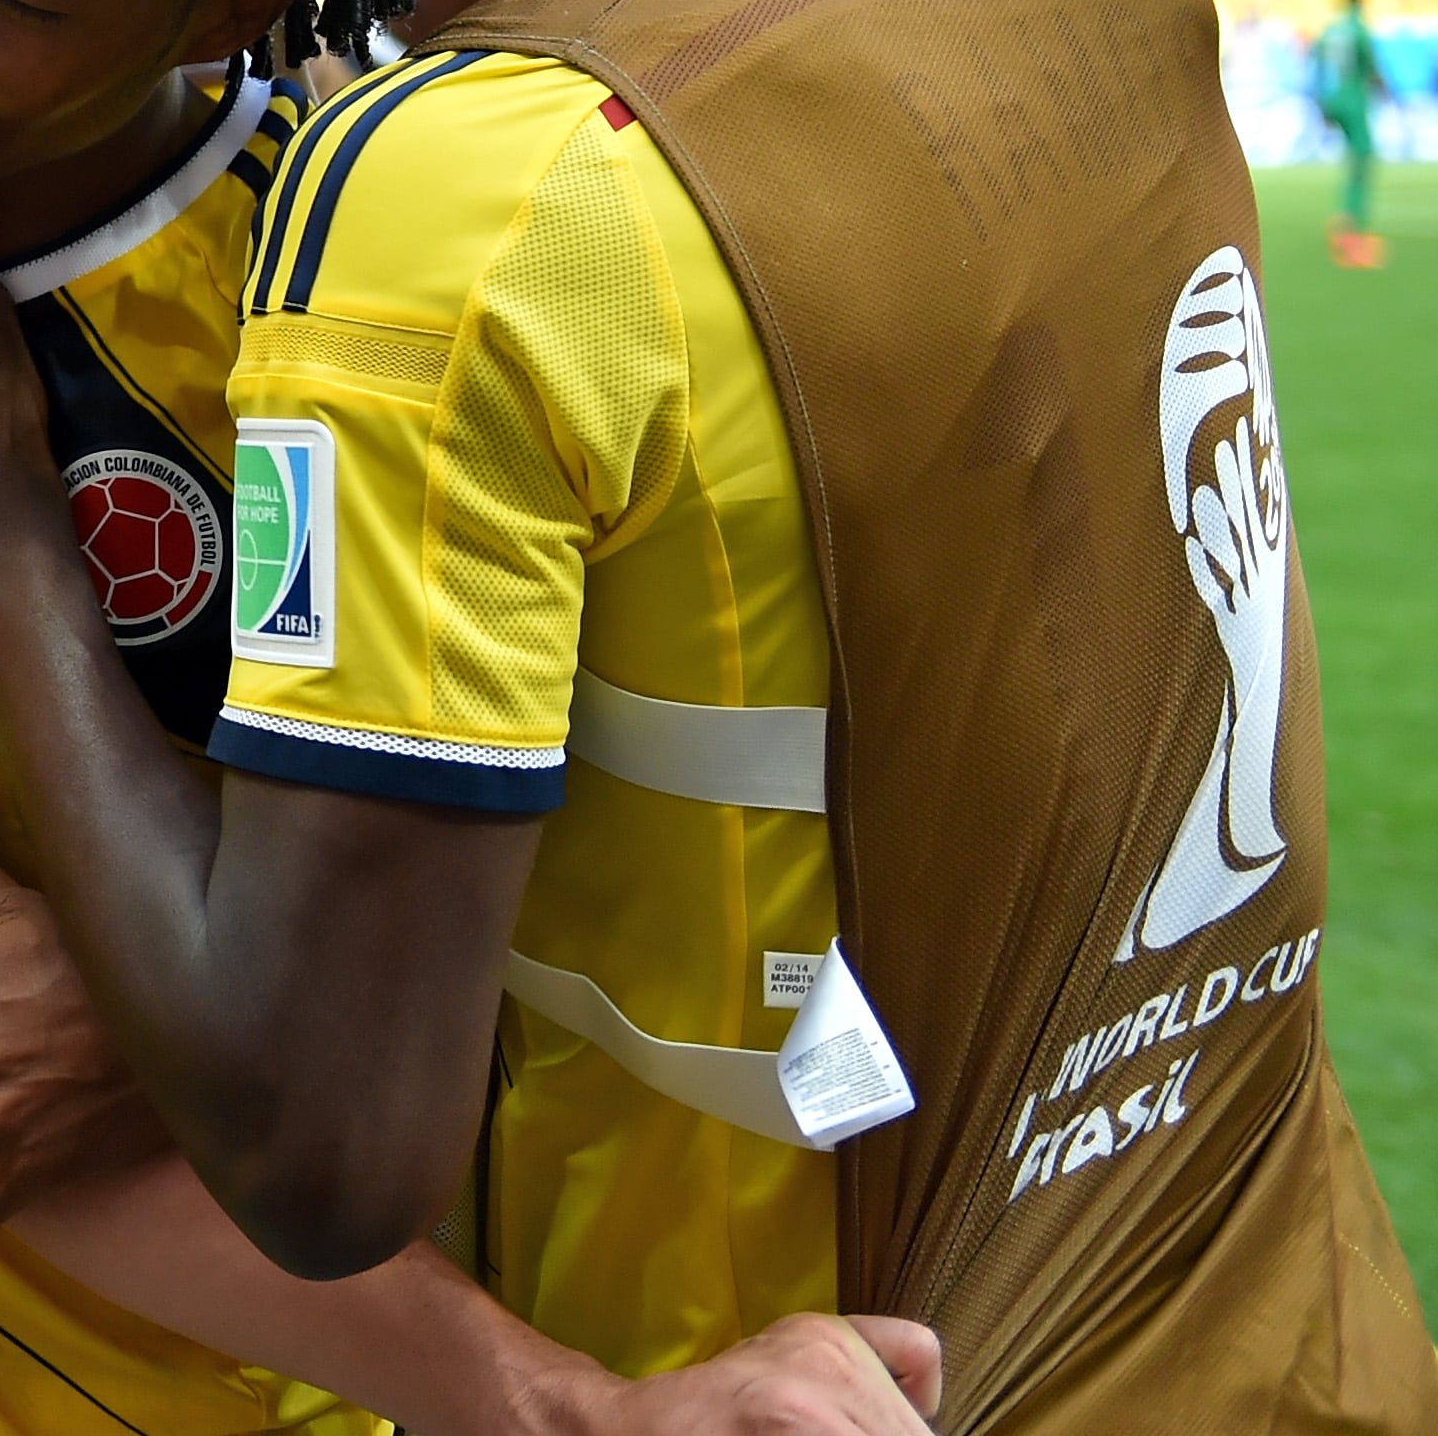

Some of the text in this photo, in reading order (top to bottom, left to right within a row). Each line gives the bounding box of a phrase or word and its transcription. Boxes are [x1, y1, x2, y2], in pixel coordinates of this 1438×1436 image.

[104, 456, 190, 498] COLOMBIANA
[186, 492, 205, 514] DE
[249, 506, 280, 523] HOPE
[195, 512, 217, 567] FUTBOL
[275, 614, 310, 634] FIFA
[774, 963, 809, 973] 02/14
[1047, 966, 1242, 1101] WORLD
